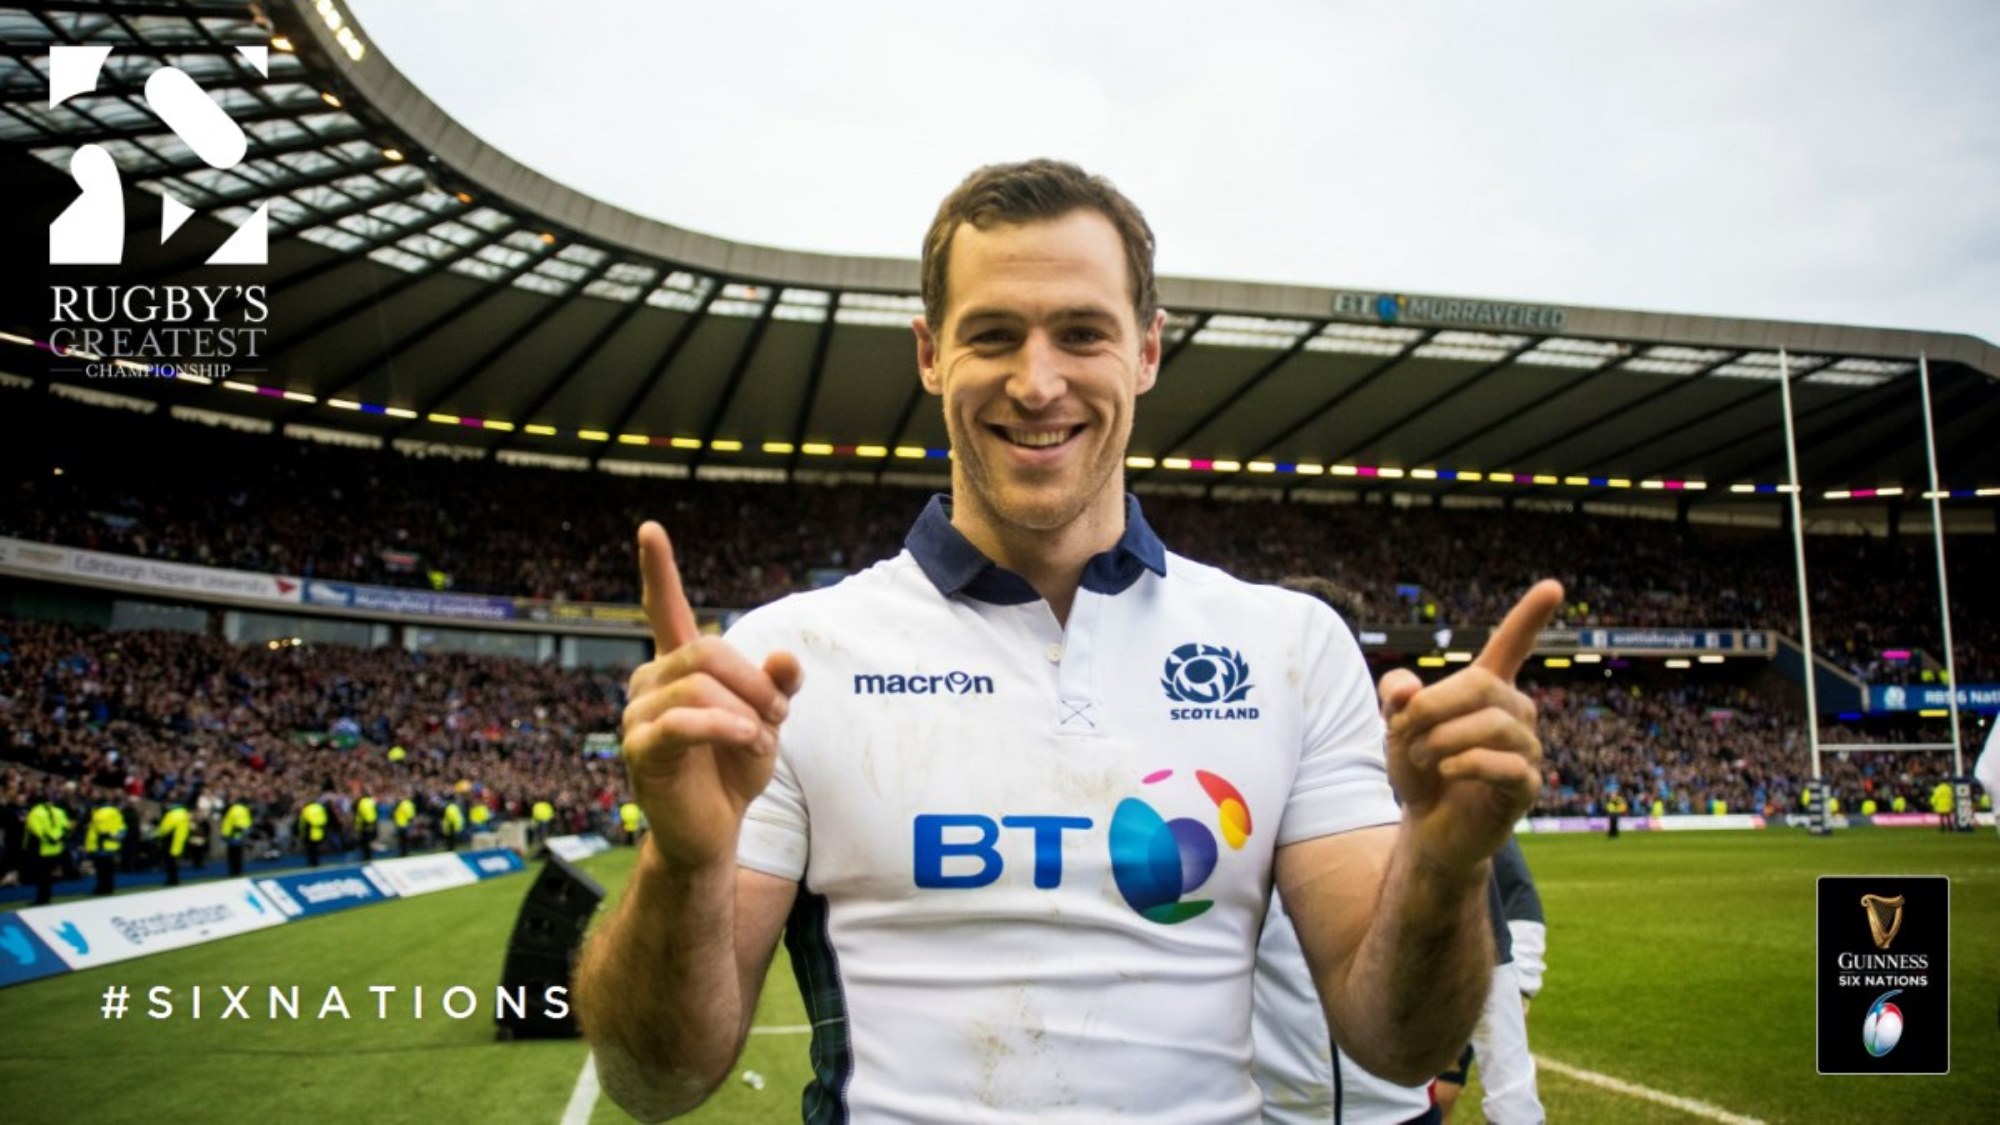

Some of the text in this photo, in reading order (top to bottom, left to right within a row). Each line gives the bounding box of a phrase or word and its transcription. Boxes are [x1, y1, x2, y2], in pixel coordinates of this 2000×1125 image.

[1333, 292, 1566, 328] BT MURRAYFIELD
[73, 553, 147, 583] Edinburgh
[853, 670, 994, 696] macron
[1170, 708, 1260, 720] SCOTLAND
[913, 813, 1094, 890] BT
